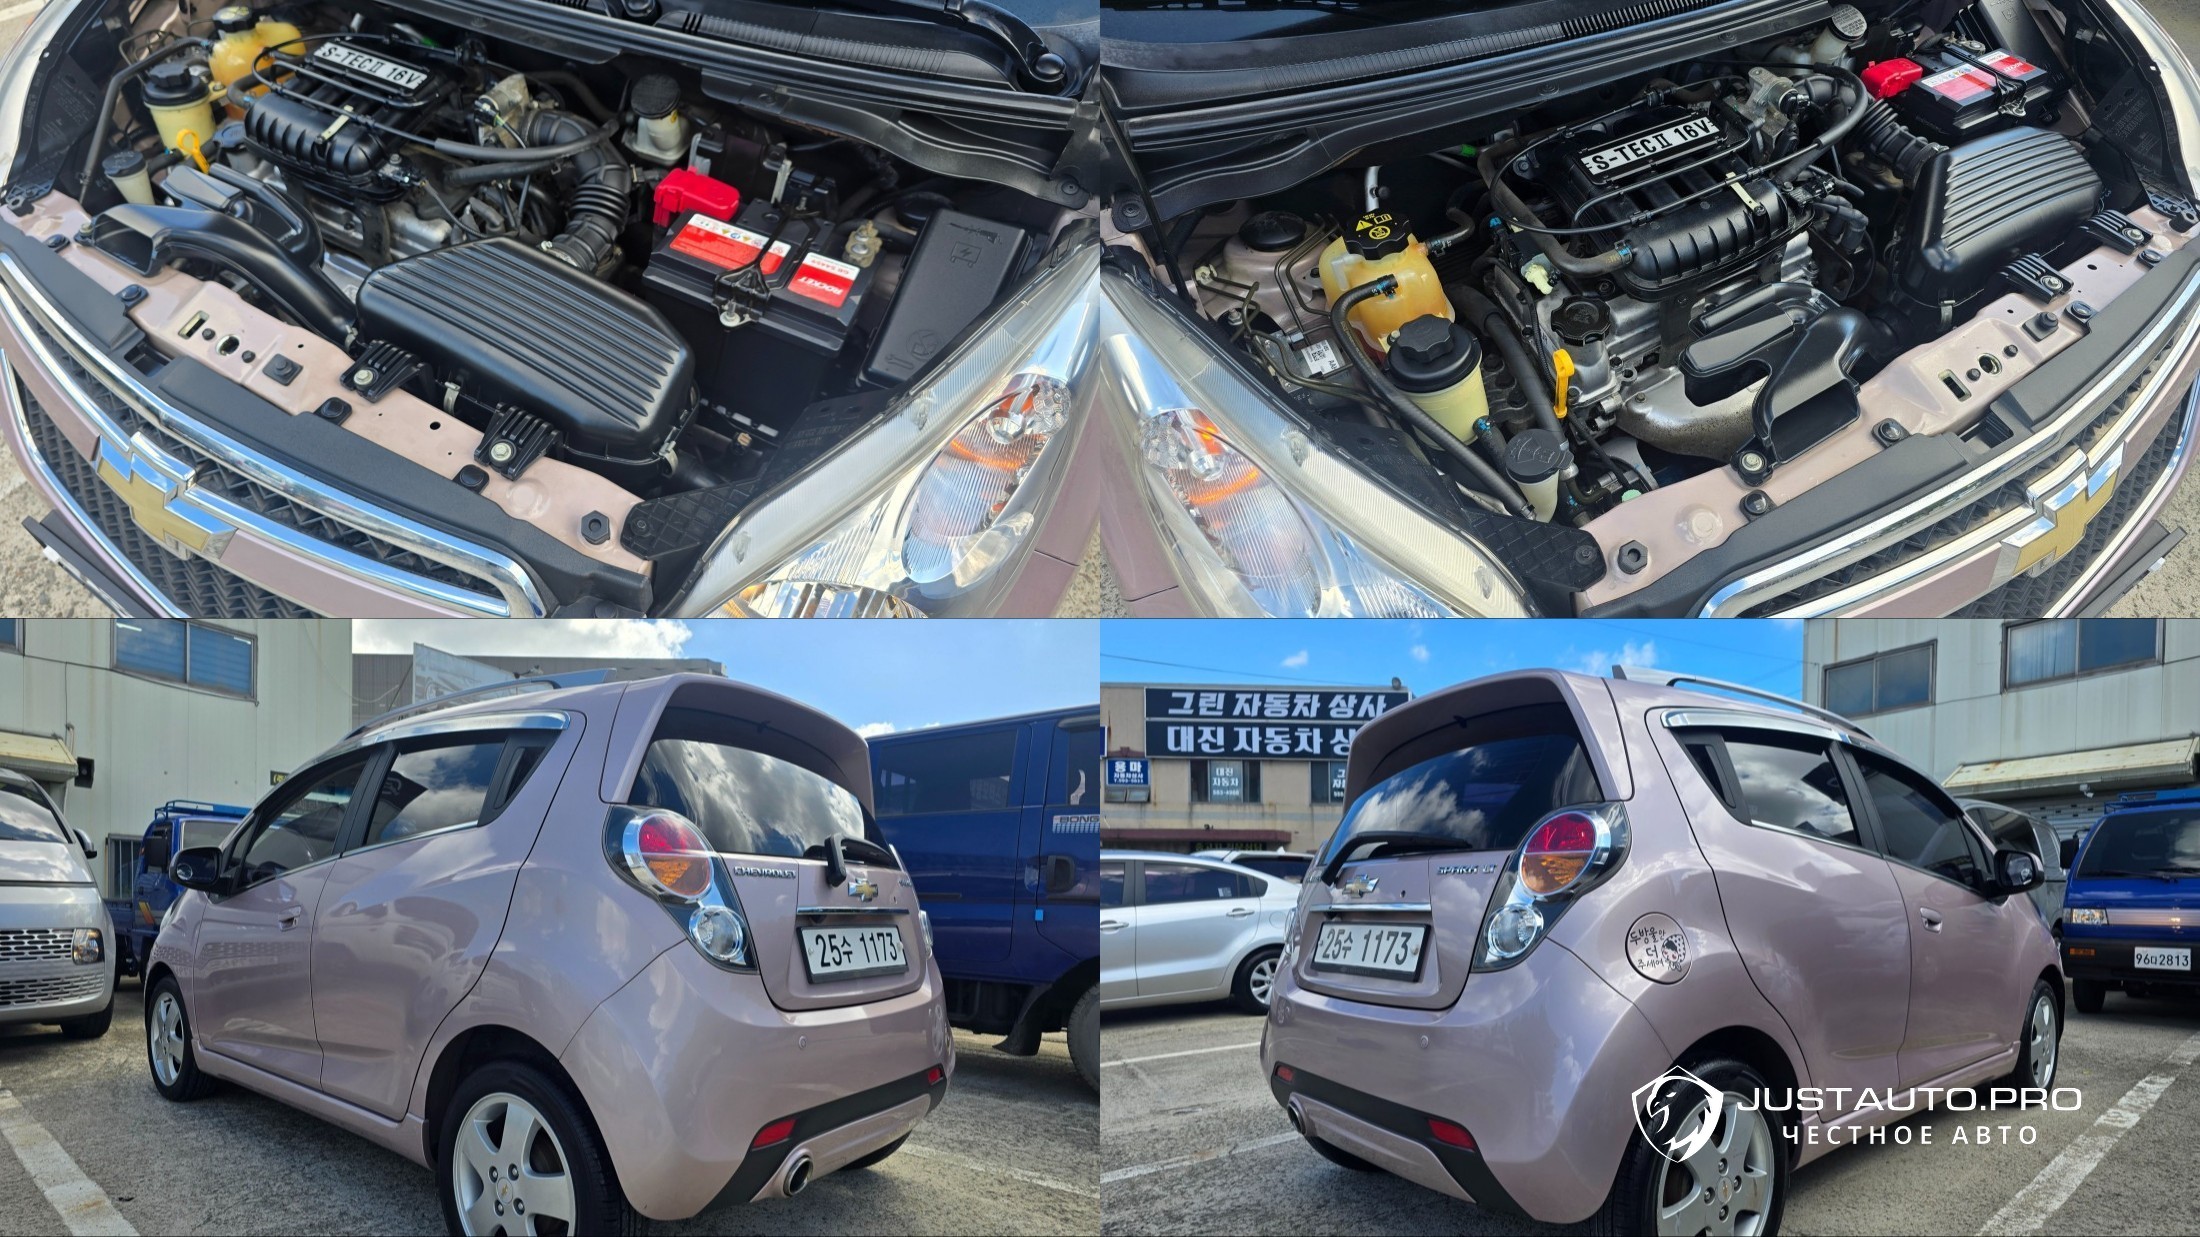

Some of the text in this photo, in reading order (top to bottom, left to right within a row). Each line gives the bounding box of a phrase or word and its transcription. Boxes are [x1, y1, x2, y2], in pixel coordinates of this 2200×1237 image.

[386, 67, 421, 85] 16V
[1673, 119, 1711, 141] 16V
[798, 276, 843, 296] ROCKET
[1167, 691, 1387, 719] 그린 자동차 상사
[1167, 725, 1226, 754] 대진
[1233, 725, 1324, 756] 자동차
[733, 866, 797, 879] CHEVROLET
[1437, 865, 1479, 876] SPARK
[859, 931, 898, 964] 1173
[1361, 929, 1412, 966] 1173
[1645, 944, 1659, 959] 더
